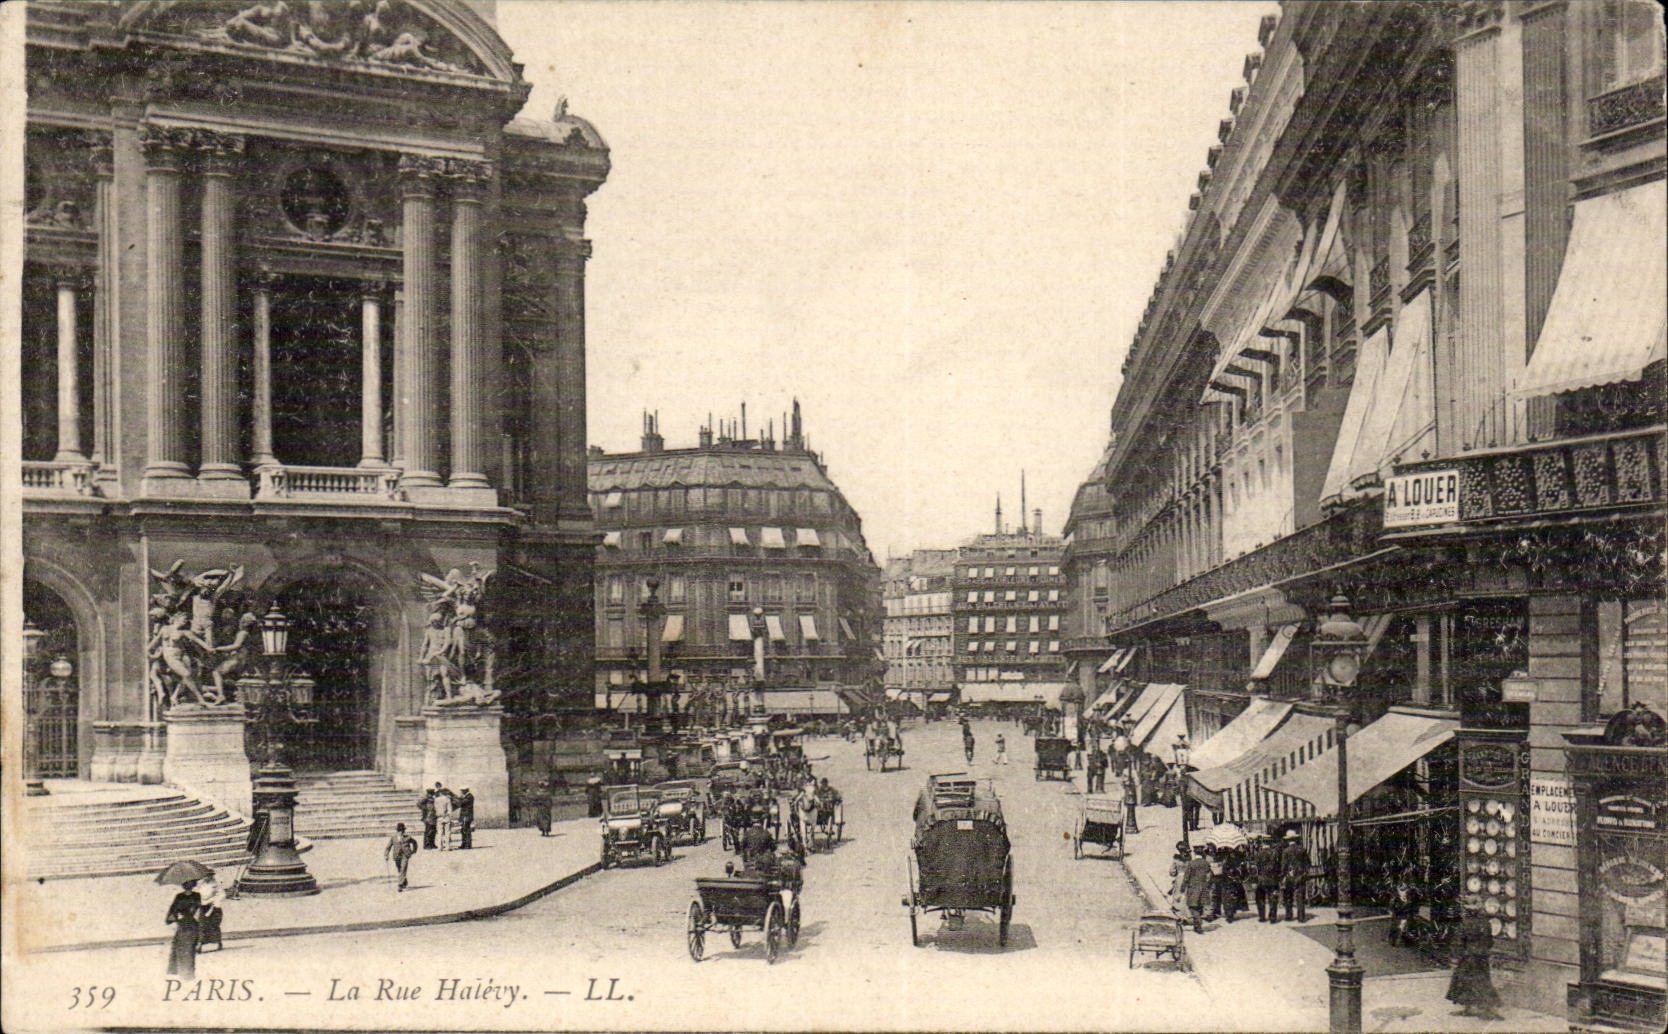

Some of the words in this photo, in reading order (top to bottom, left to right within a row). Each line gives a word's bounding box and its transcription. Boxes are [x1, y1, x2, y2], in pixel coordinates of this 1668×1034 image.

[1387, 481, 1397, 508] A
[1403, 474, 1456, 507] LOUER
[1534, 800, 1541, 810] A
